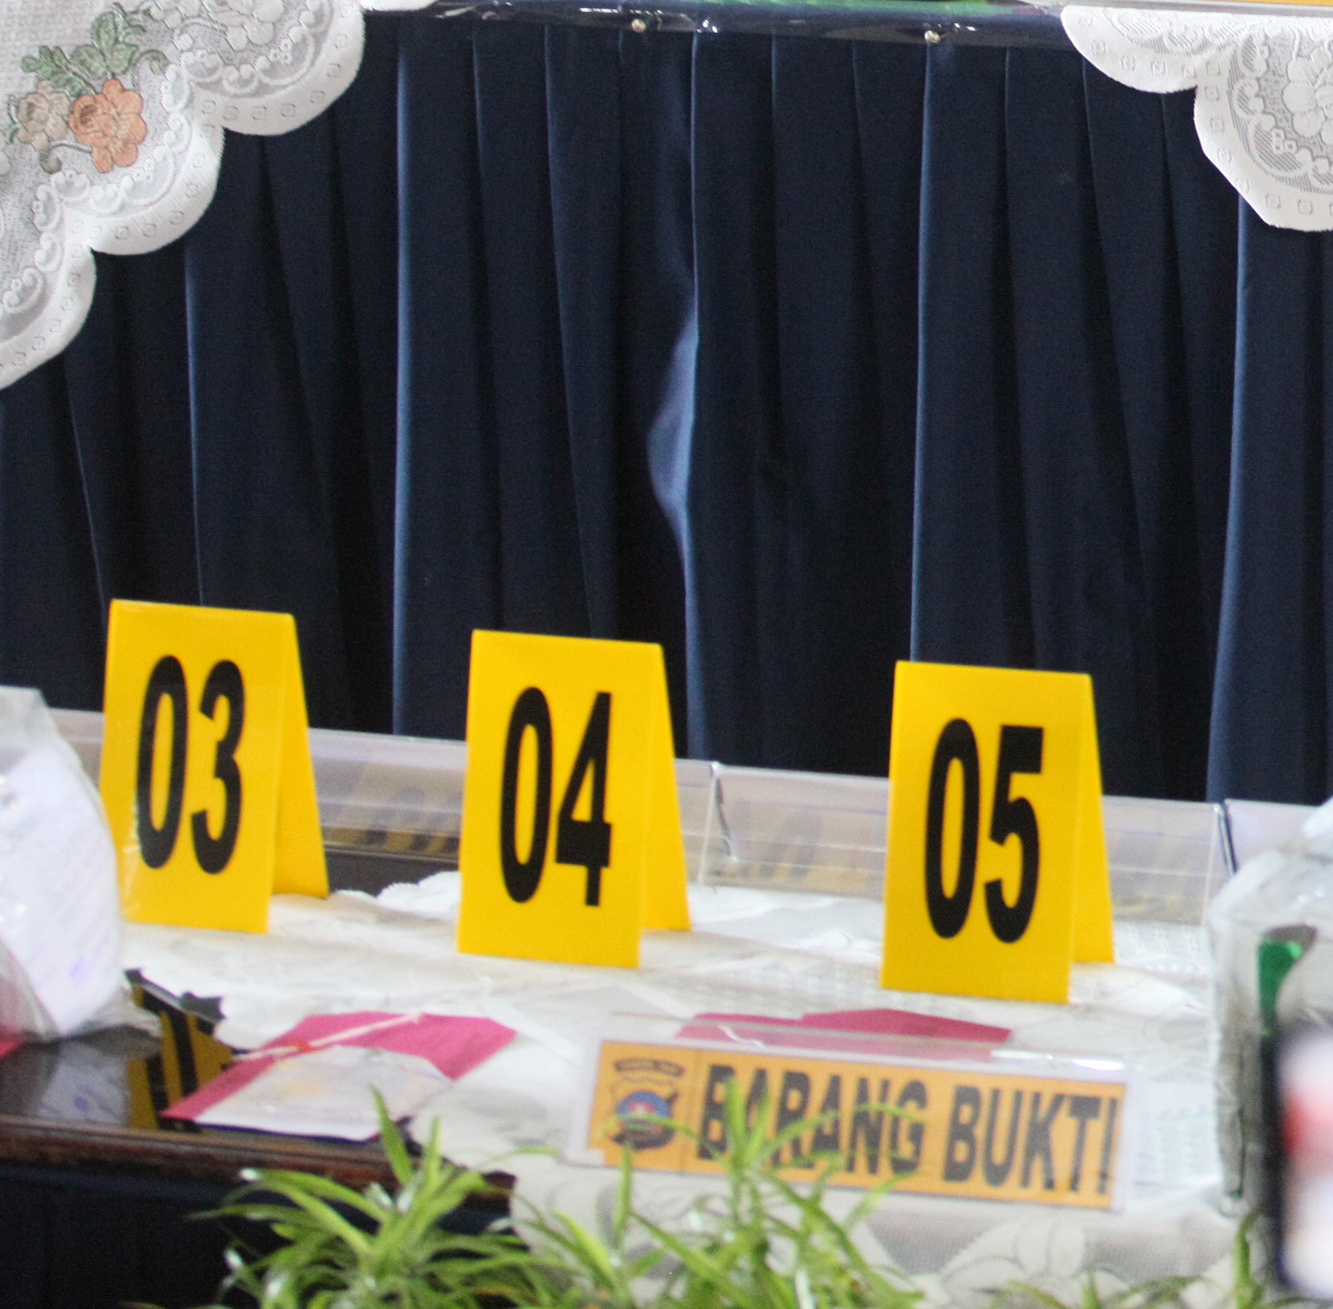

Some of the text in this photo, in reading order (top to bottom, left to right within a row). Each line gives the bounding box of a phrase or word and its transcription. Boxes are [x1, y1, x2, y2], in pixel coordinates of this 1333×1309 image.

[135, 654, 245, 875] 03
[499, 686, 612, 908] 04
[924, 717, 1044, 944] 05
[941, 1084, 1121, 1197] BUKTI
